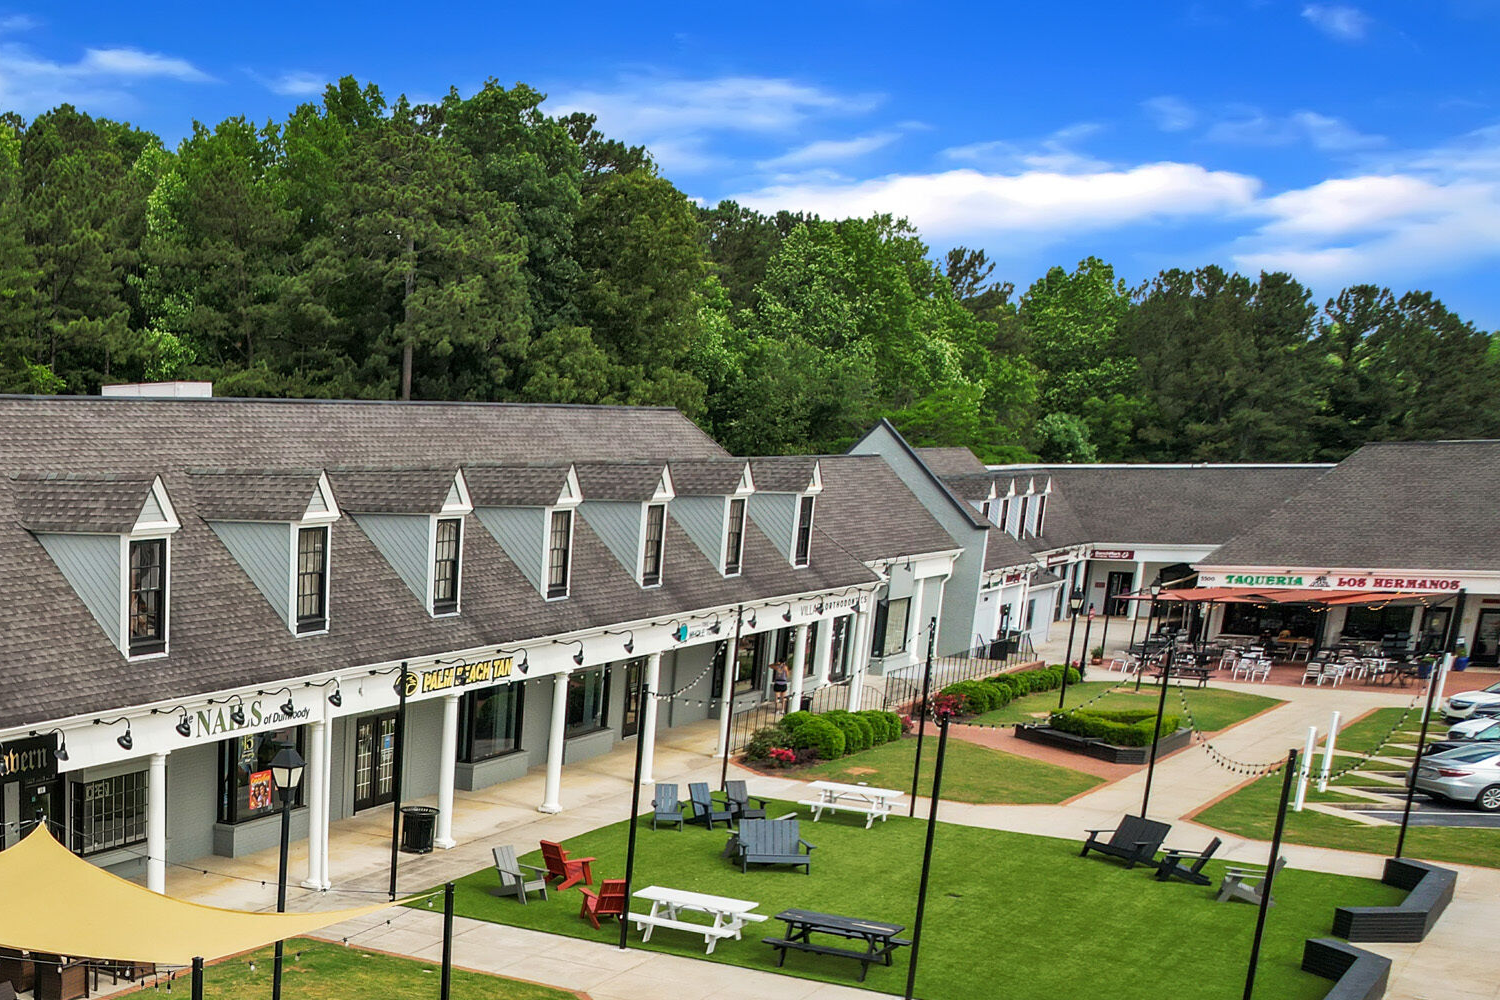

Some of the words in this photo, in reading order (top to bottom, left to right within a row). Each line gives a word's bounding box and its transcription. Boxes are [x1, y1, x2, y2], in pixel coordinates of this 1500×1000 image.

[1225, 575, 1303, 586] TAQUERIA
[1337, 577, 1367, 588] LOS
[1372, 579, 1460, 590] HERMANOS
[422, 667, 454, 693] PALM
[492, 656, 514, 679] TAN
[263, 713, 272, 725] of
